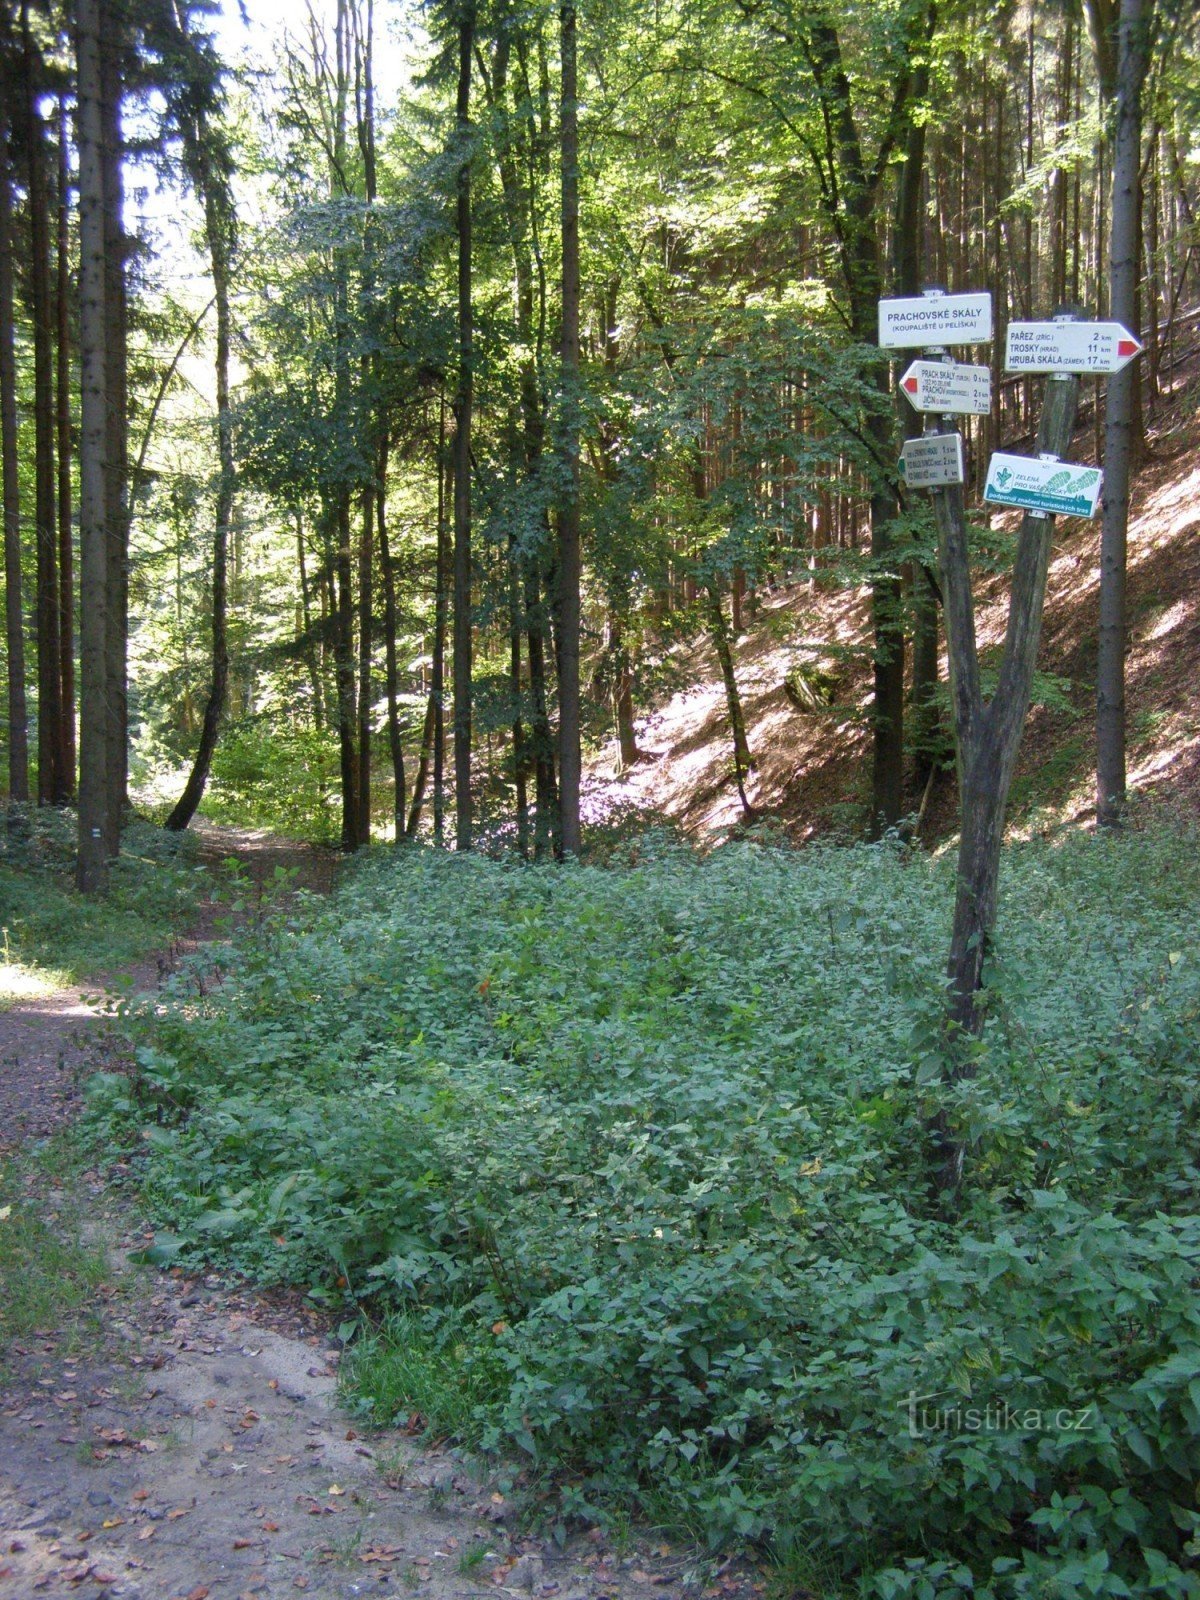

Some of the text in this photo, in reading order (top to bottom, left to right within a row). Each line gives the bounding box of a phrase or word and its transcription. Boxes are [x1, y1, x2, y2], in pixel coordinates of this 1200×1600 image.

[887, 308, 982, 322] PRACHOVSKÉ SKÁLY
[892, 322, 937, 333] (KOUPALIŠTĚ
[945, 321, 977, 329] PELÍŠKA)
[1010, 331, 1034, 341] PAŘEZ
[1093, 332, 1099, 341] 2
[1010, 344, 1040, 352] TROSKY
[1088, 344, 1097, 352] 11
[1009, 355, 1035, 364] HRUBÁ
[1037, 355, 1062, 364] SKÁLA
[1087, 356, 1098, 364] 17
[922, 385, 946, 395] PRACHOV
[1015, 474, 1040, 483] ZELENÁ
[1040, 501, 1076, 512] turistických
